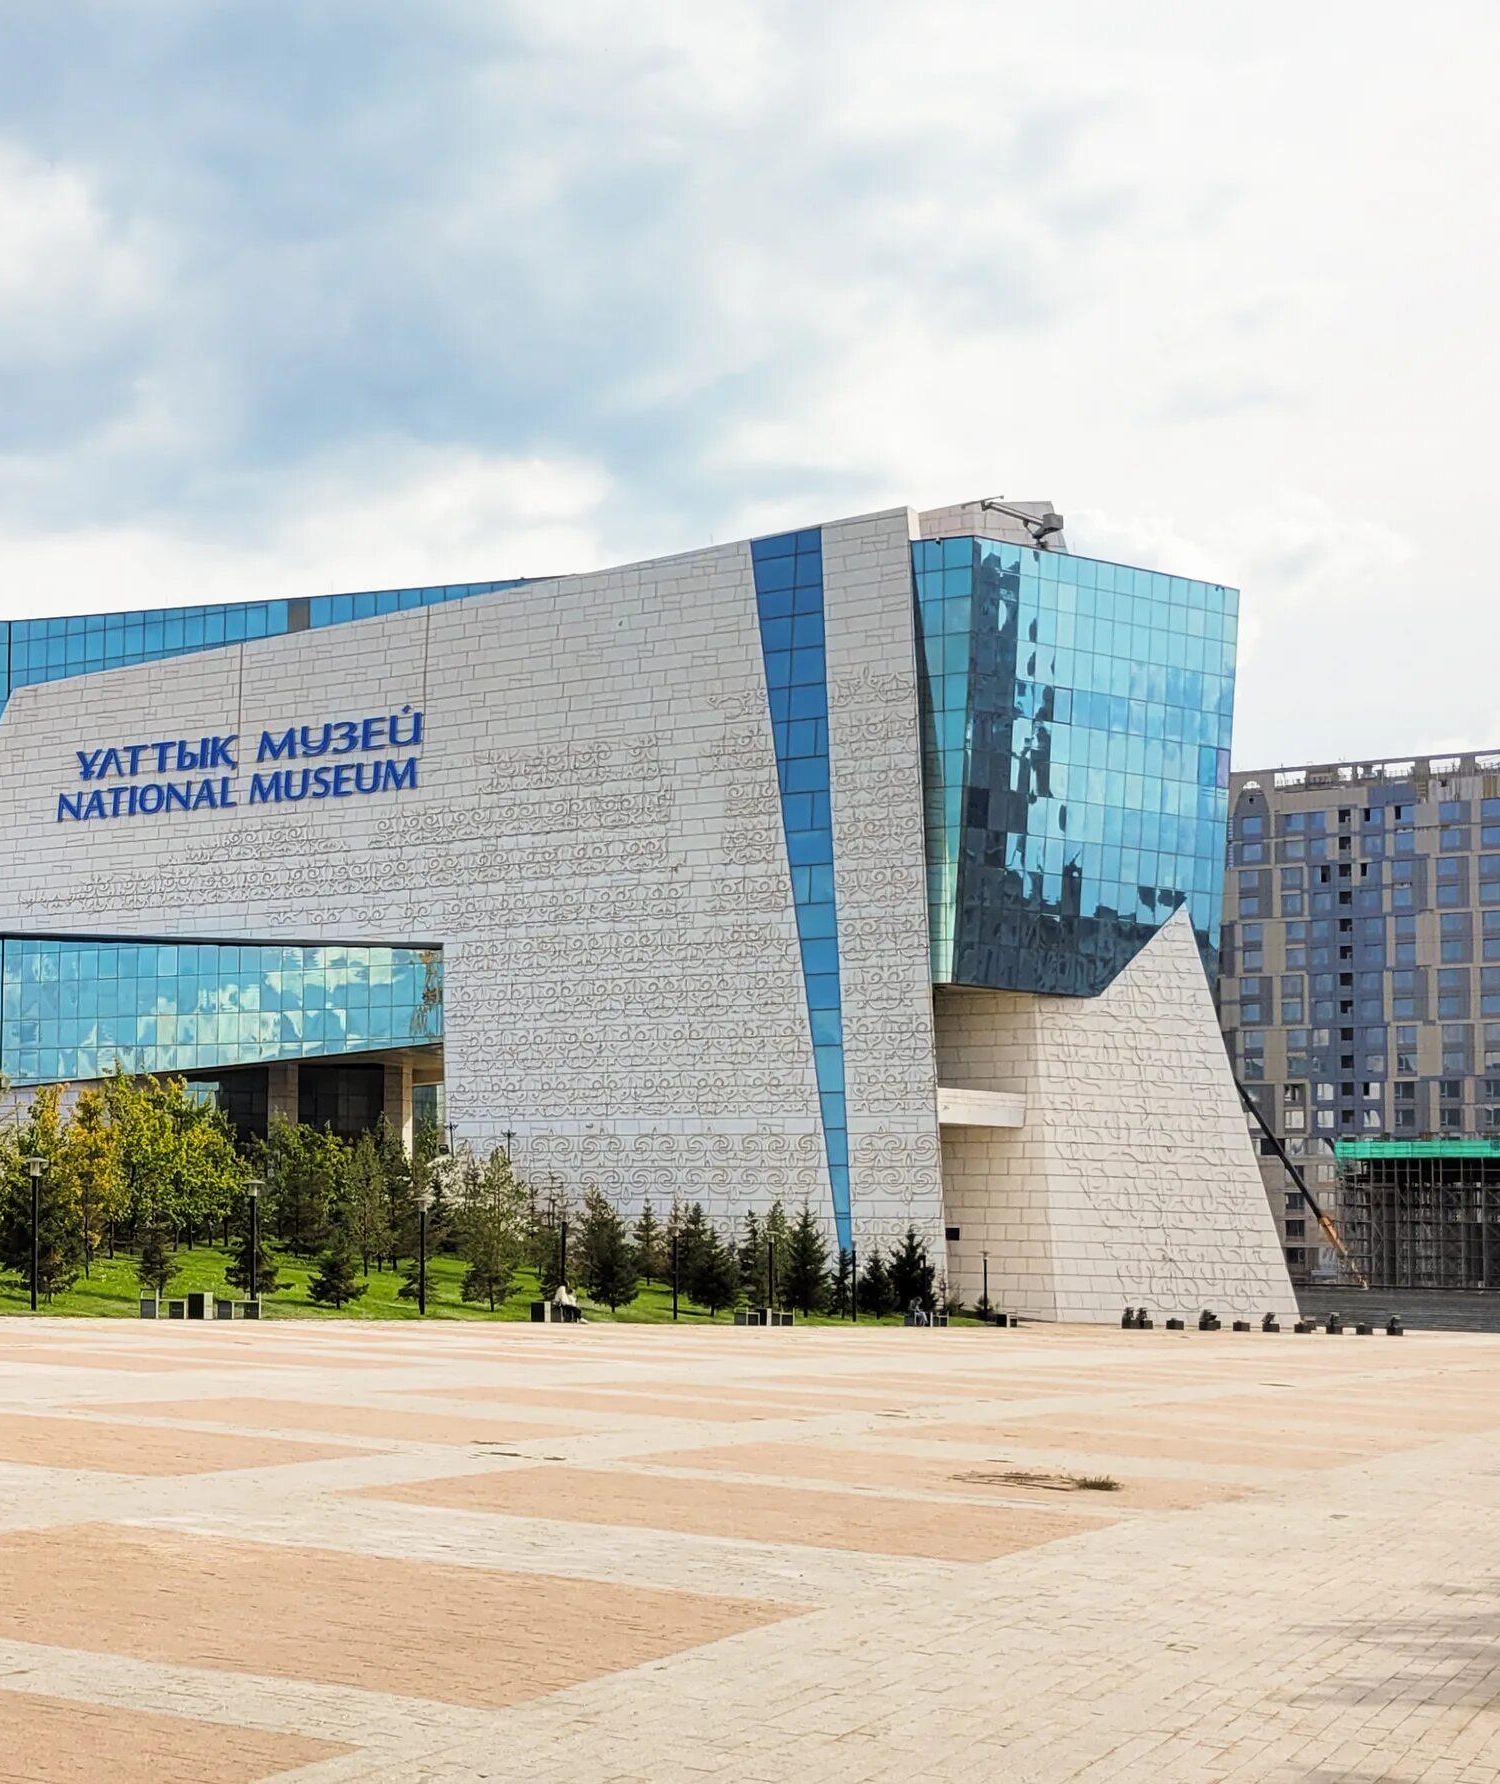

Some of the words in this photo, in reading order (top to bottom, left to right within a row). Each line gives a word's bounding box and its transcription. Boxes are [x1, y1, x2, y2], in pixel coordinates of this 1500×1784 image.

[76, 733, 239, 781] ҰЛТТЫҚ
[257, 704, 423, 762] МУЗЕЙ
[57, 776, 238, 821] NATIONAL
[249, 757, 417, 804] MUSEUM
